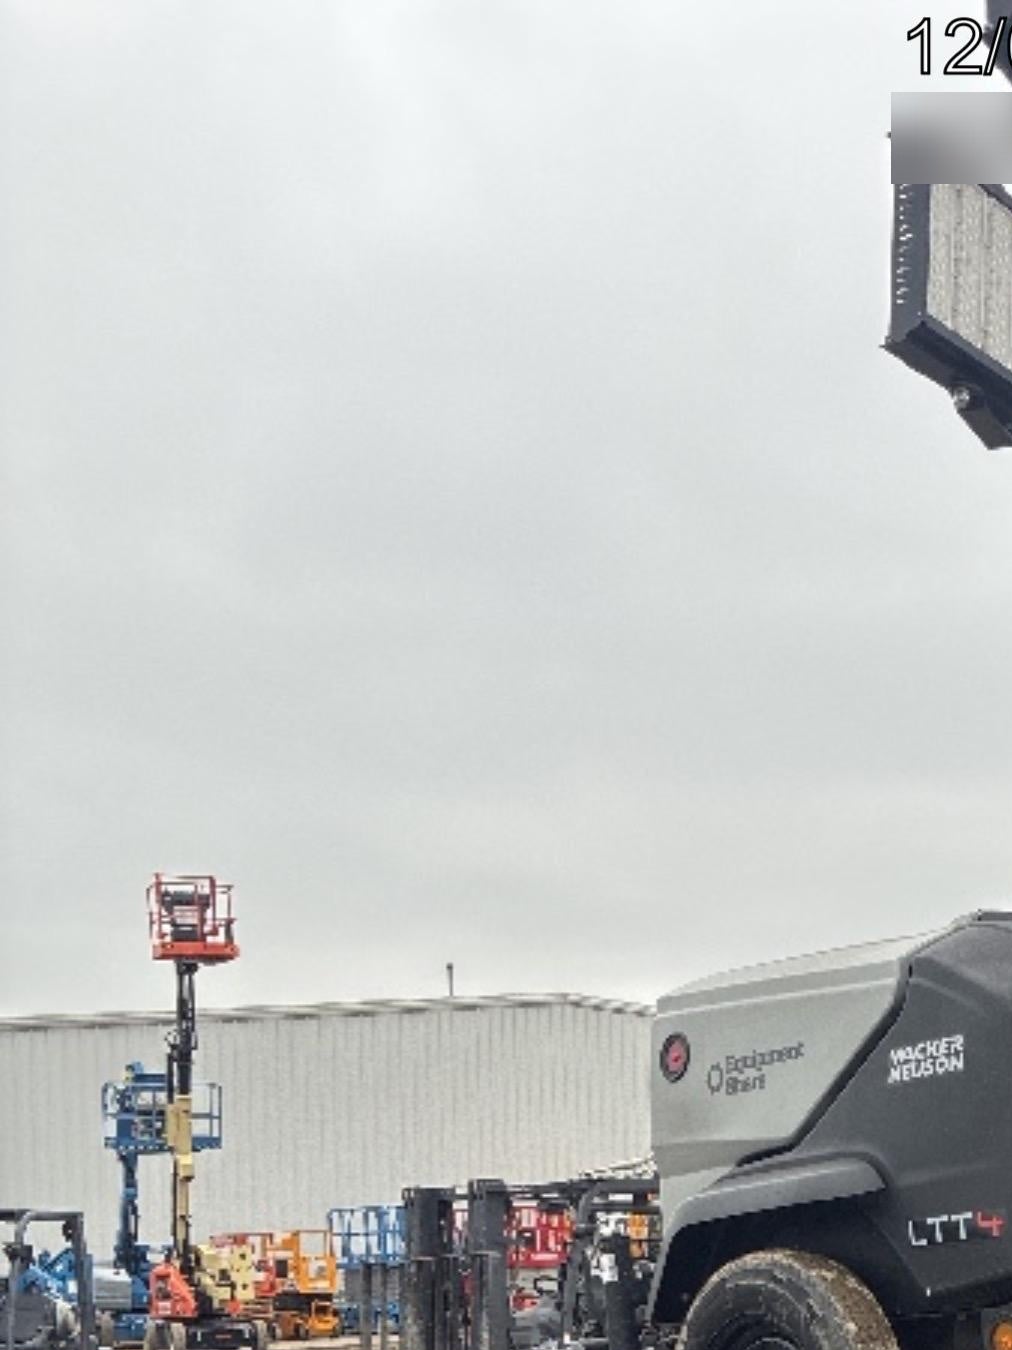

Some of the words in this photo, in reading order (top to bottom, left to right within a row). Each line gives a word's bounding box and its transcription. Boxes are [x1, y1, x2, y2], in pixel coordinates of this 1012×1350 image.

[725, 1042, 804, 1074] Equipment
[890, 1034, 964, 1065] WACKER
[888, 1052, 964, 1083] NEUSON
